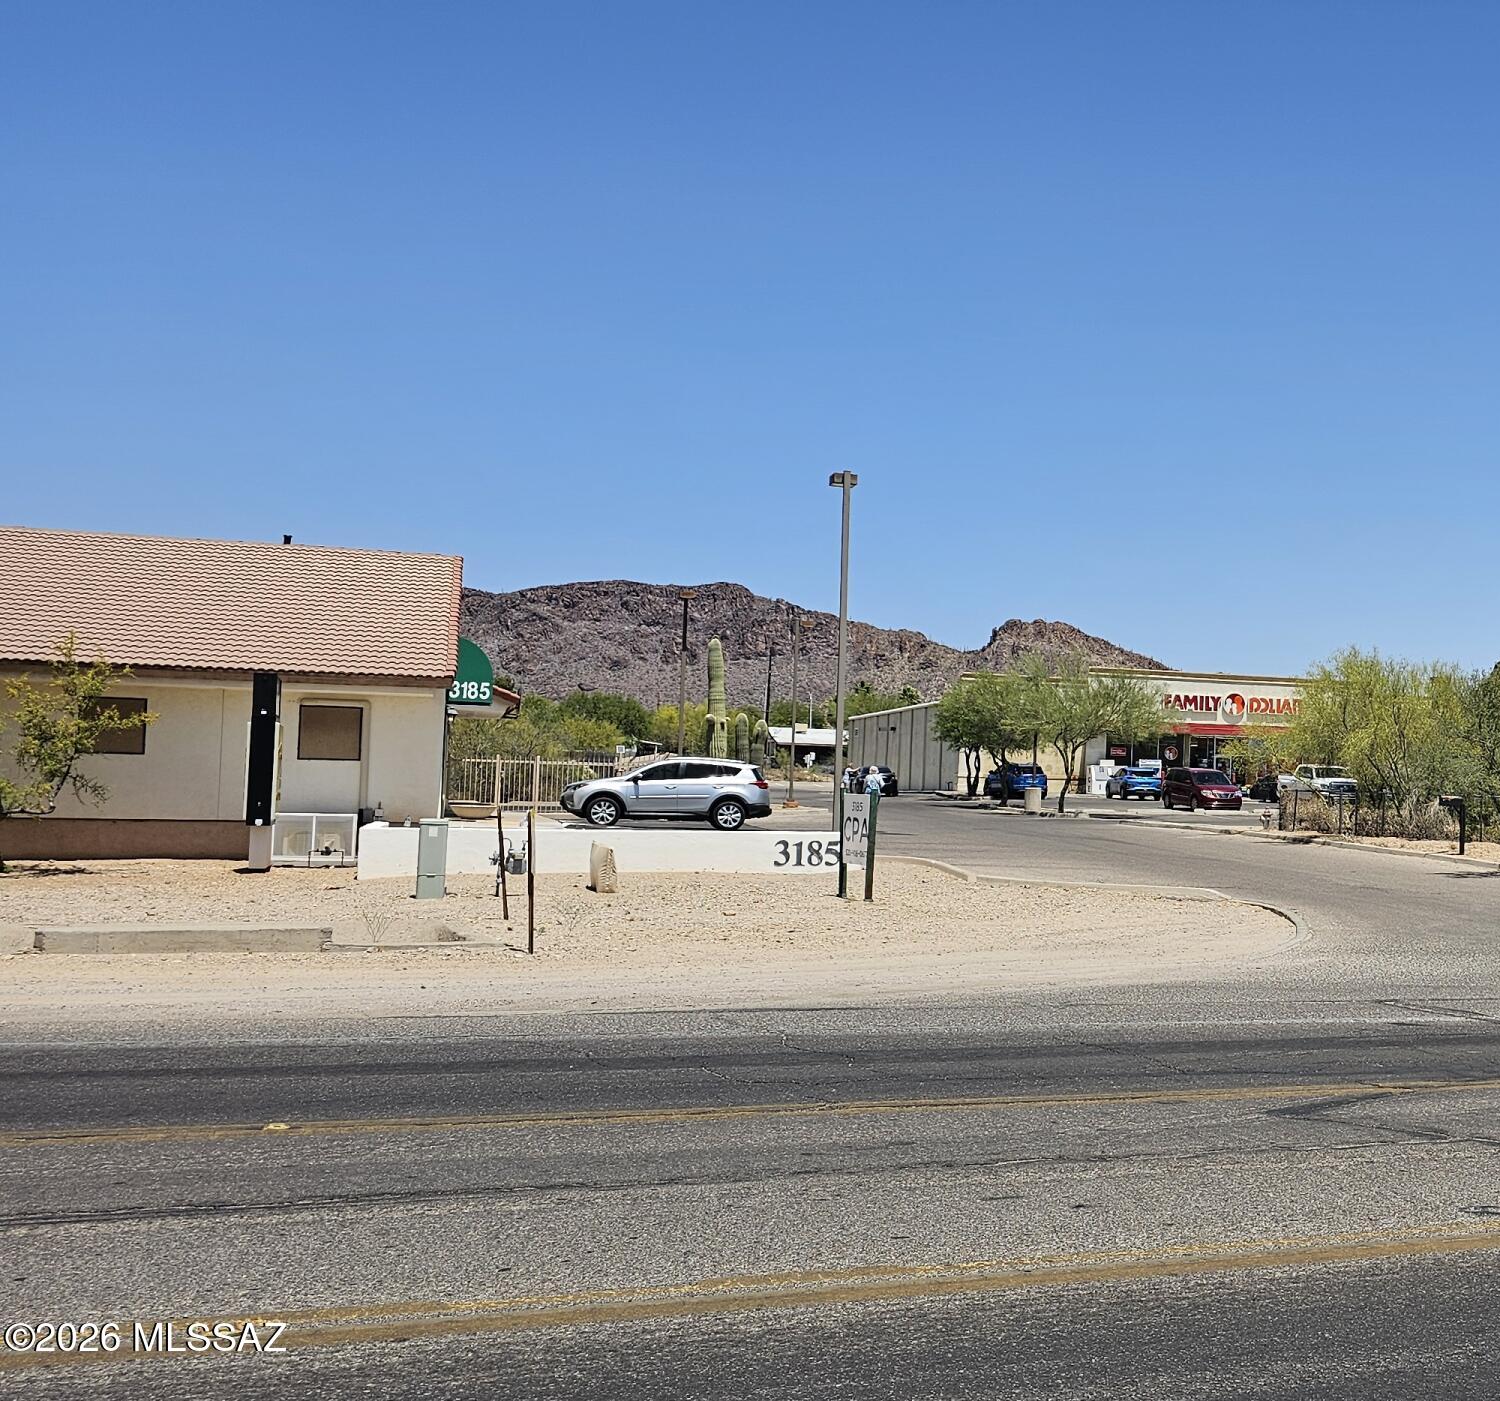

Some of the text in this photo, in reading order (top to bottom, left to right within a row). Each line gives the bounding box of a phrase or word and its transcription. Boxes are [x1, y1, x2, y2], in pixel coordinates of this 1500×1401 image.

[448, 680, 491, 700] 3185
[1163, 693, 1221, 712] FAMILY
[844, 816, 868, 843] CPA
[773, 839, 840, 867] 3185
